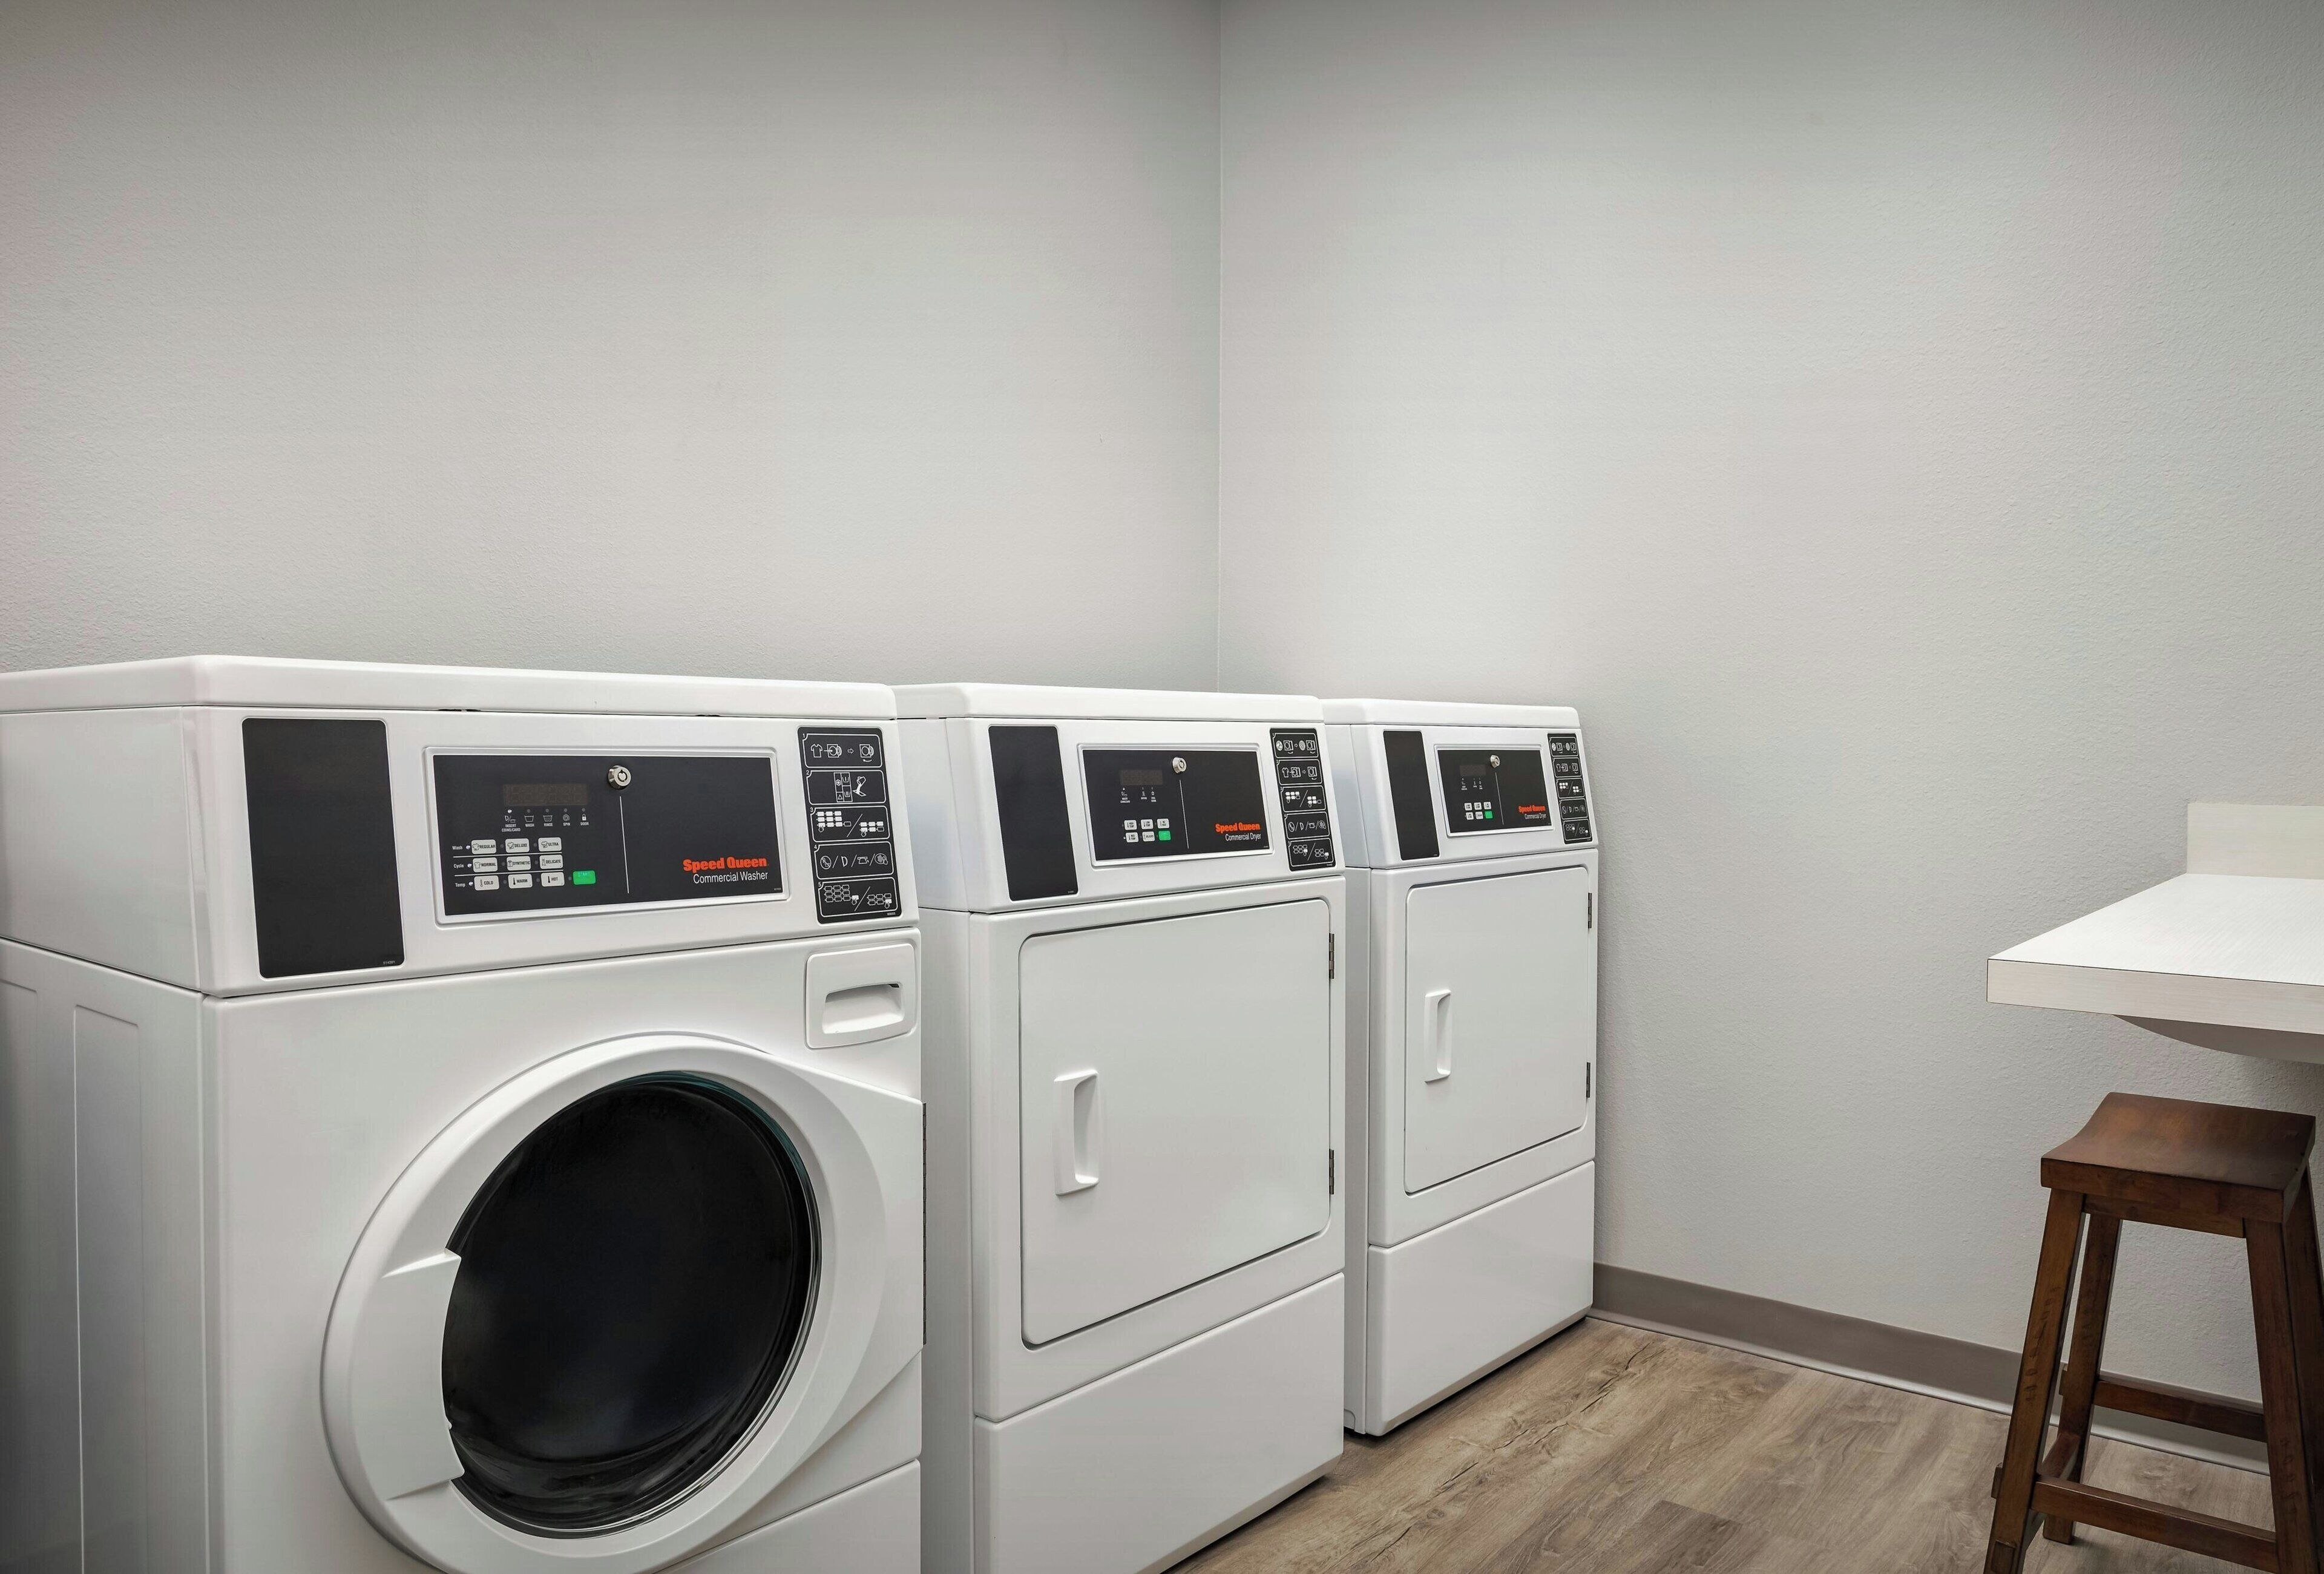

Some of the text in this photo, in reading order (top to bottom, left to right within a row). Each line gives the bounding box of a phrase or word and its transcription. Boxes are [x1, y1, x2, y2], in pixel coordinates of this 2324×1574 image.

[1518, 805, 1532, 813] Speed
[1215, 822, 1260, 833] Speed Queen
[1225, 832, 1261, 841] Commercial Dryer
[683, 856, 767, 873] Speed Queen
[693, 870, 768, 884] Commercial Washer
